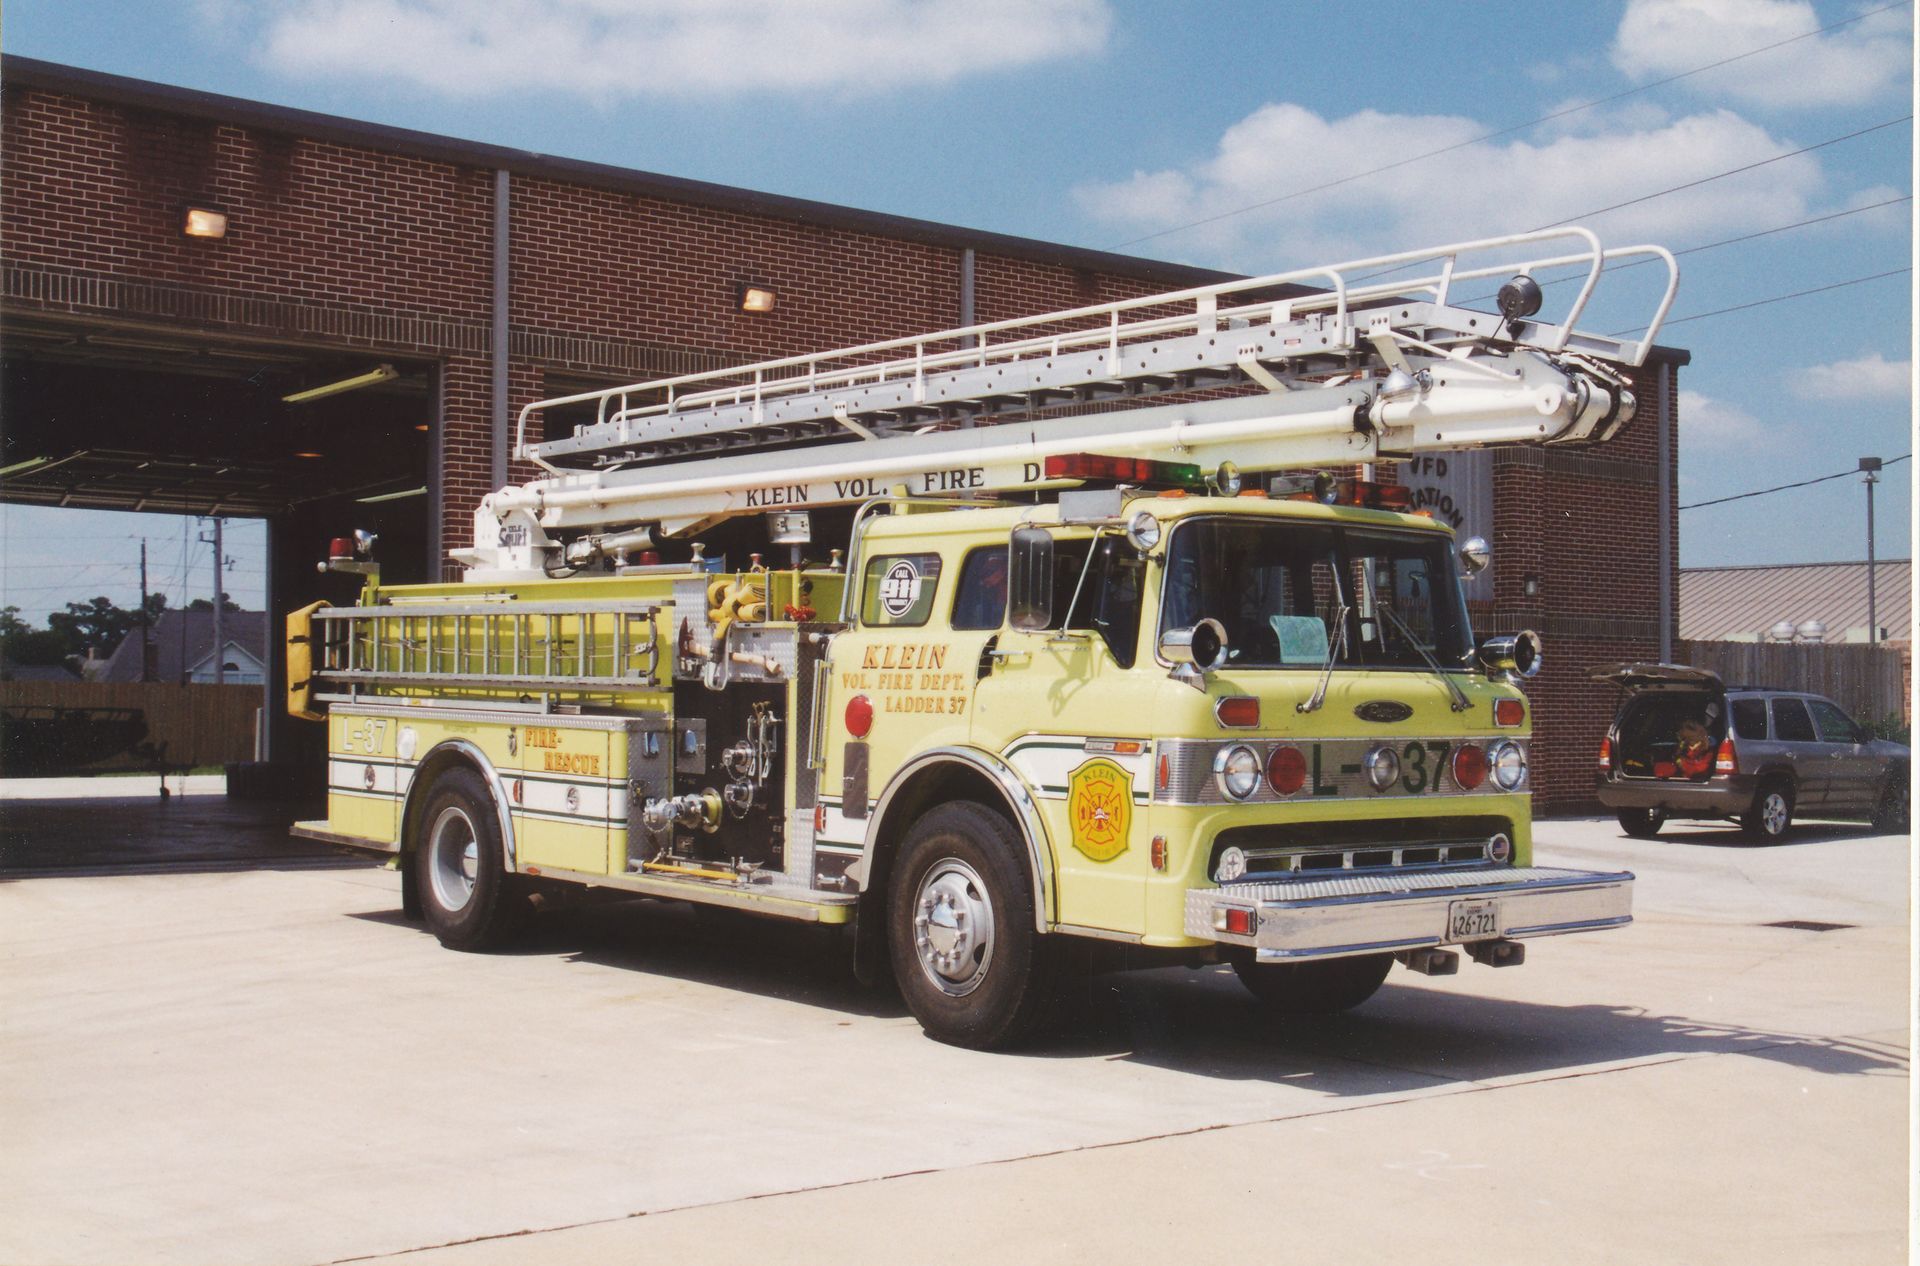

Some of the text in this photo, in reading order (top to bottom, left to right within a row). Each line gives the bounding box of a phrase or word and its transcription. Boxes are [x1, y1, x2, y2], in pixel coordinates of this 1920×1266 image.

[1409, 456, 1448, 477] VFD
[745, 484, 809, 507] KLEIN
[833, 477, 888, 498] VOL.
[923, 467, 985, 491] FIRE
[1408, 486, 1464, 529] TATION
[894, 569, 909, 578] CALL
[880, 578, 922, 600] 911
[861, 643, 950, 669] KLEIN
[842, 673, 965, 690] VOL. FIRE DEPT.
[885, 696, 968, 715] LADDER 37
[343, 716, 387, 753] L-37
[525, 727, 562, 748] FIRE-
[544, 751, 600, 775] RESCUE
[1083, 768, 1117, 782] KLEIN
